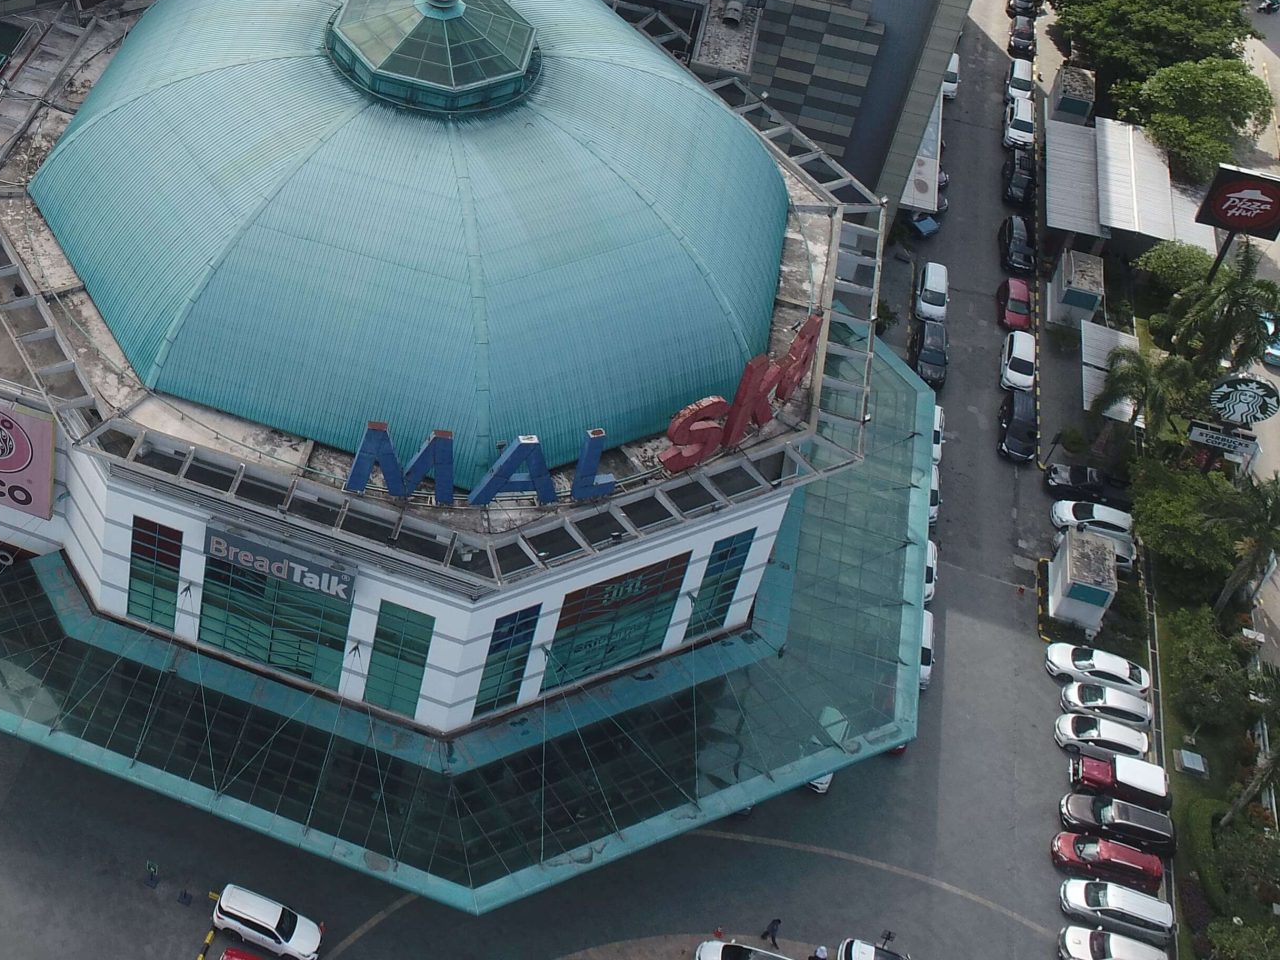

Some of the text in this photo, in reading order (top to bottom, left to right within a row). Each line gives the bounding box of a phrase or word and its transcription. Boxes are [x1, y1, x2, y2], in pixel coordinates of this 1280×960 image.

[1221, 197, 1271, 211] Pizza
[1226, 207, 1264, 218] Hut
[345, 315, 824, 506] MAL SKA
[1199, 432, 1250, 448] STARBUCKS
[1205, 438, 1240, 451] COFFEE
